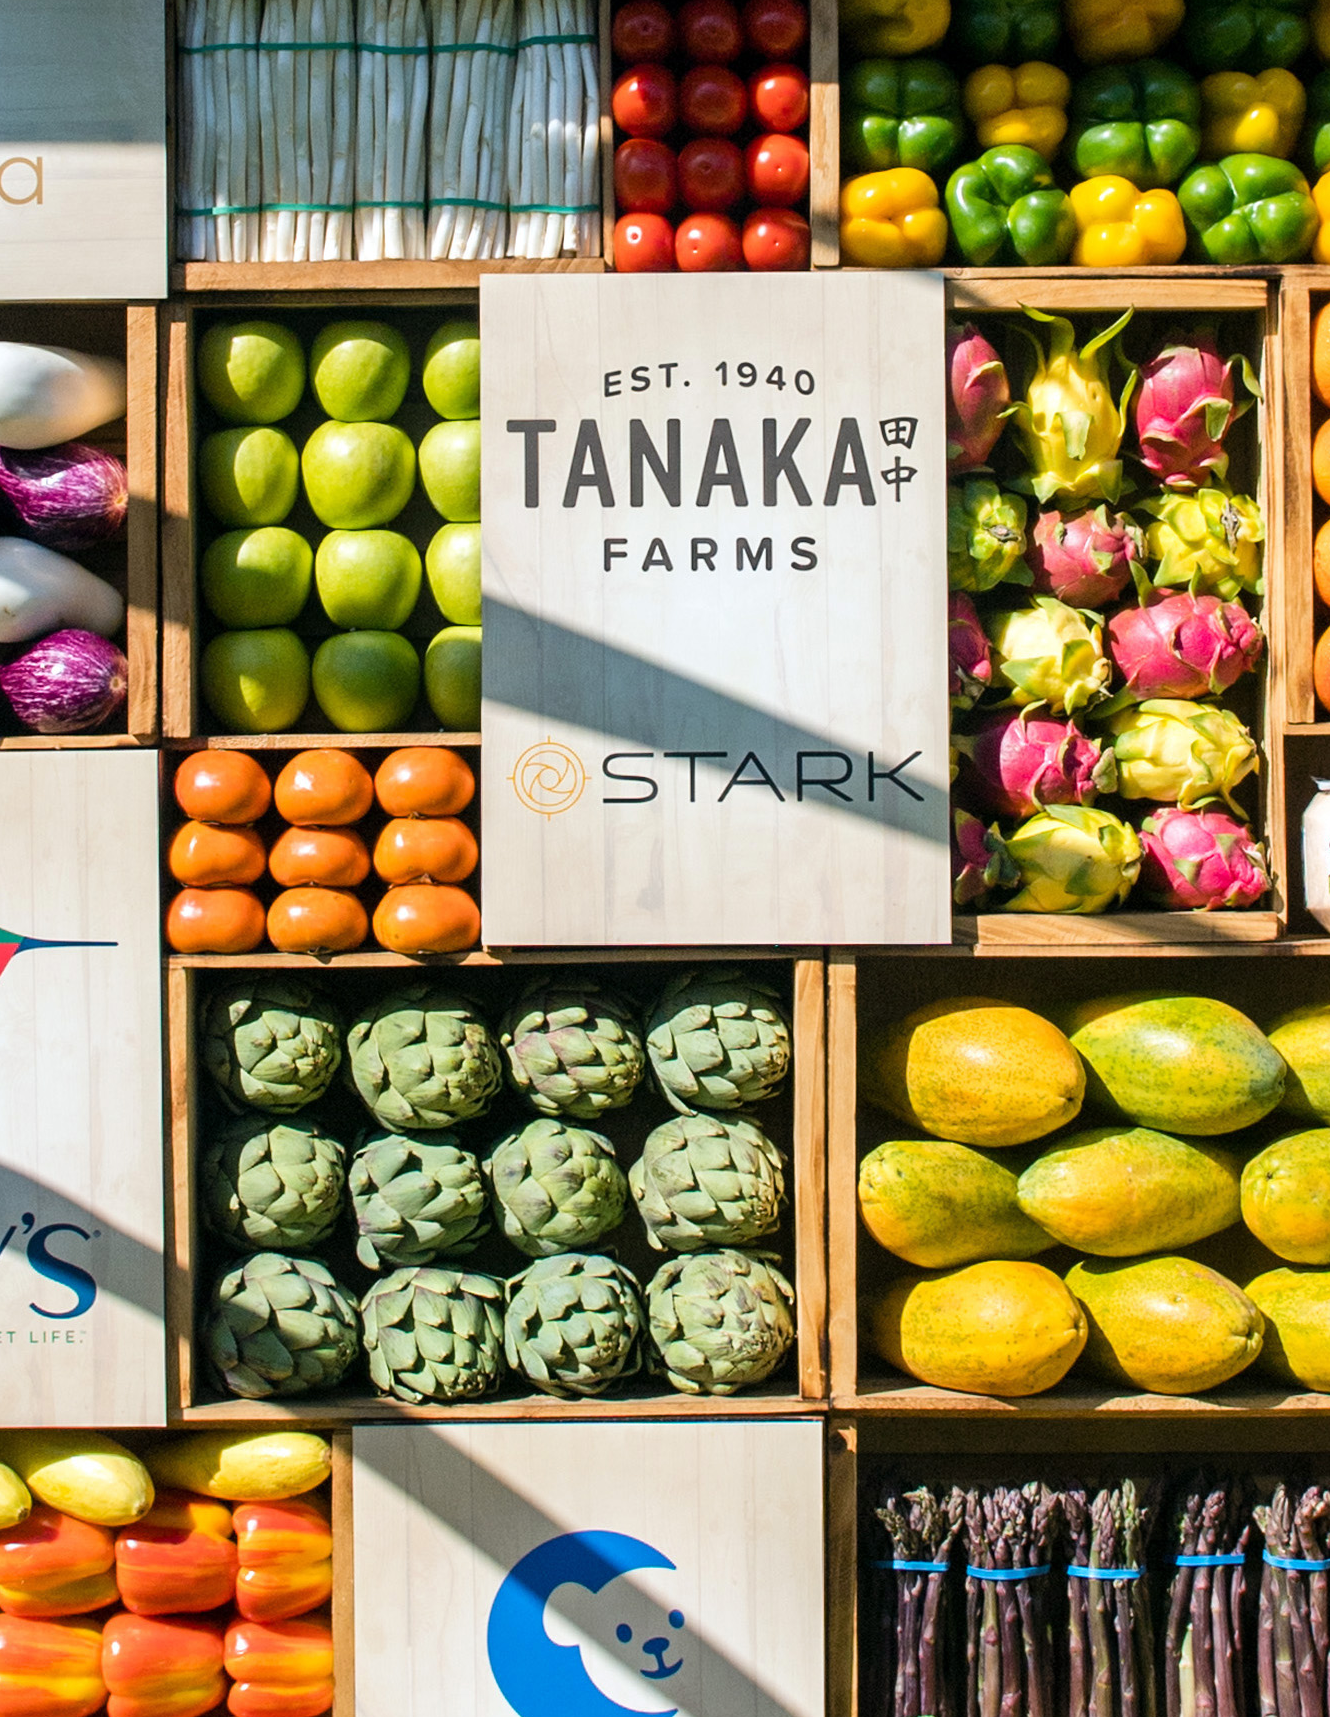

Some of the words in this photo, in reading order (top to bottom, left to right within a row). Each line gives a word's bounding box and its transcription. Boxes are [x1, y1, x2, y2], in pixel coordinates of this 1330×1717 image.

[603, 362, 691, 398] EST.
[715, 361, 816, 396] 1940
[506, 417, 877, 508] TANAKA
[879, 416, 918, 503] 田中
[603, 536, 818, 572] FARMS
[601, 750, 925, 804] STARK
